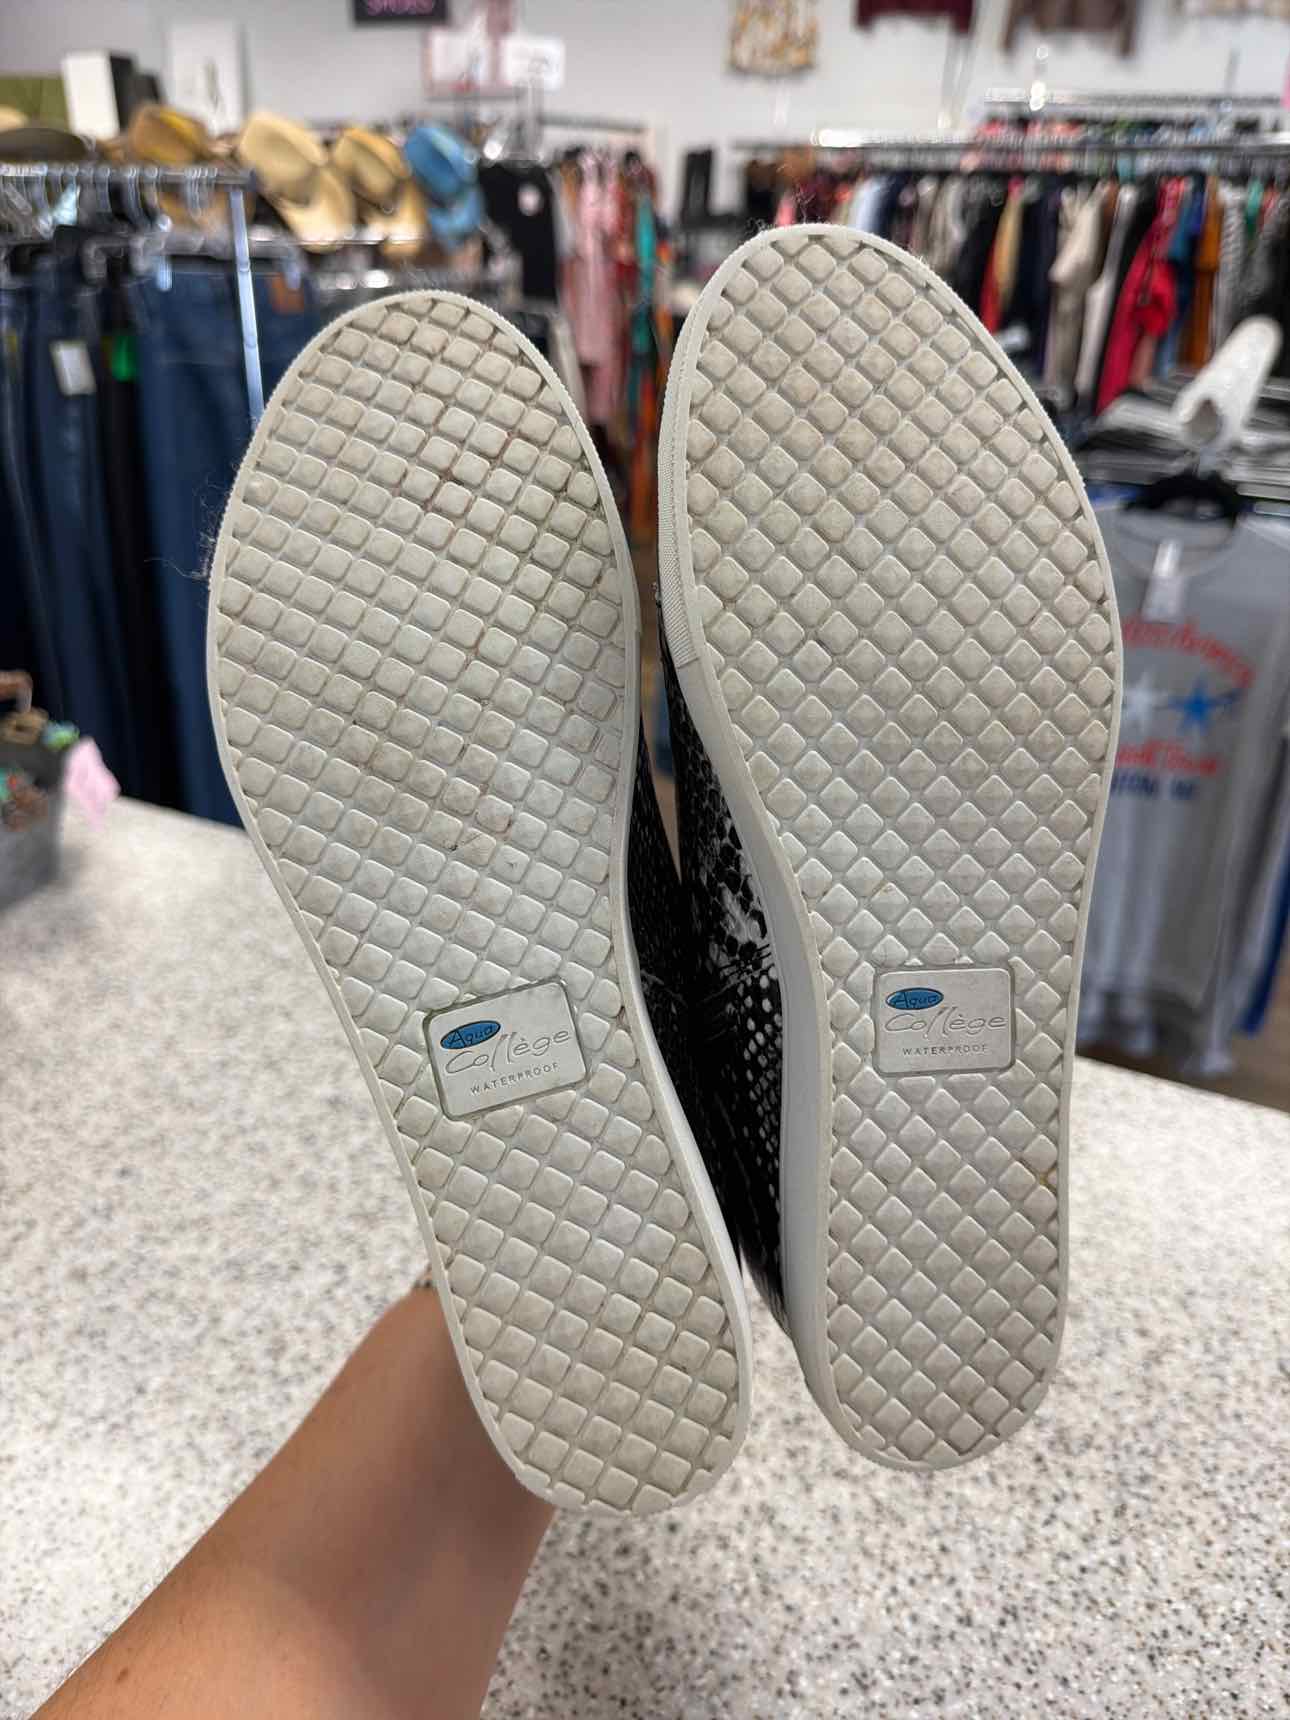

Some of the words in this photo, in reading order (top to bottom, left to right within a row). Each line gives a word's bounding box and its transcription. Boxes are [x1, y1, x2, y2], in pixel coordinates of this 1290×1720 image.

[887, 991, 938, 1008] Aqua
[449, 1024, 494, 1047] Aqua
[903, 1044, 986, 1056] WATERPROOF
[470, 1062, 559, 1094] WATERPROOF
